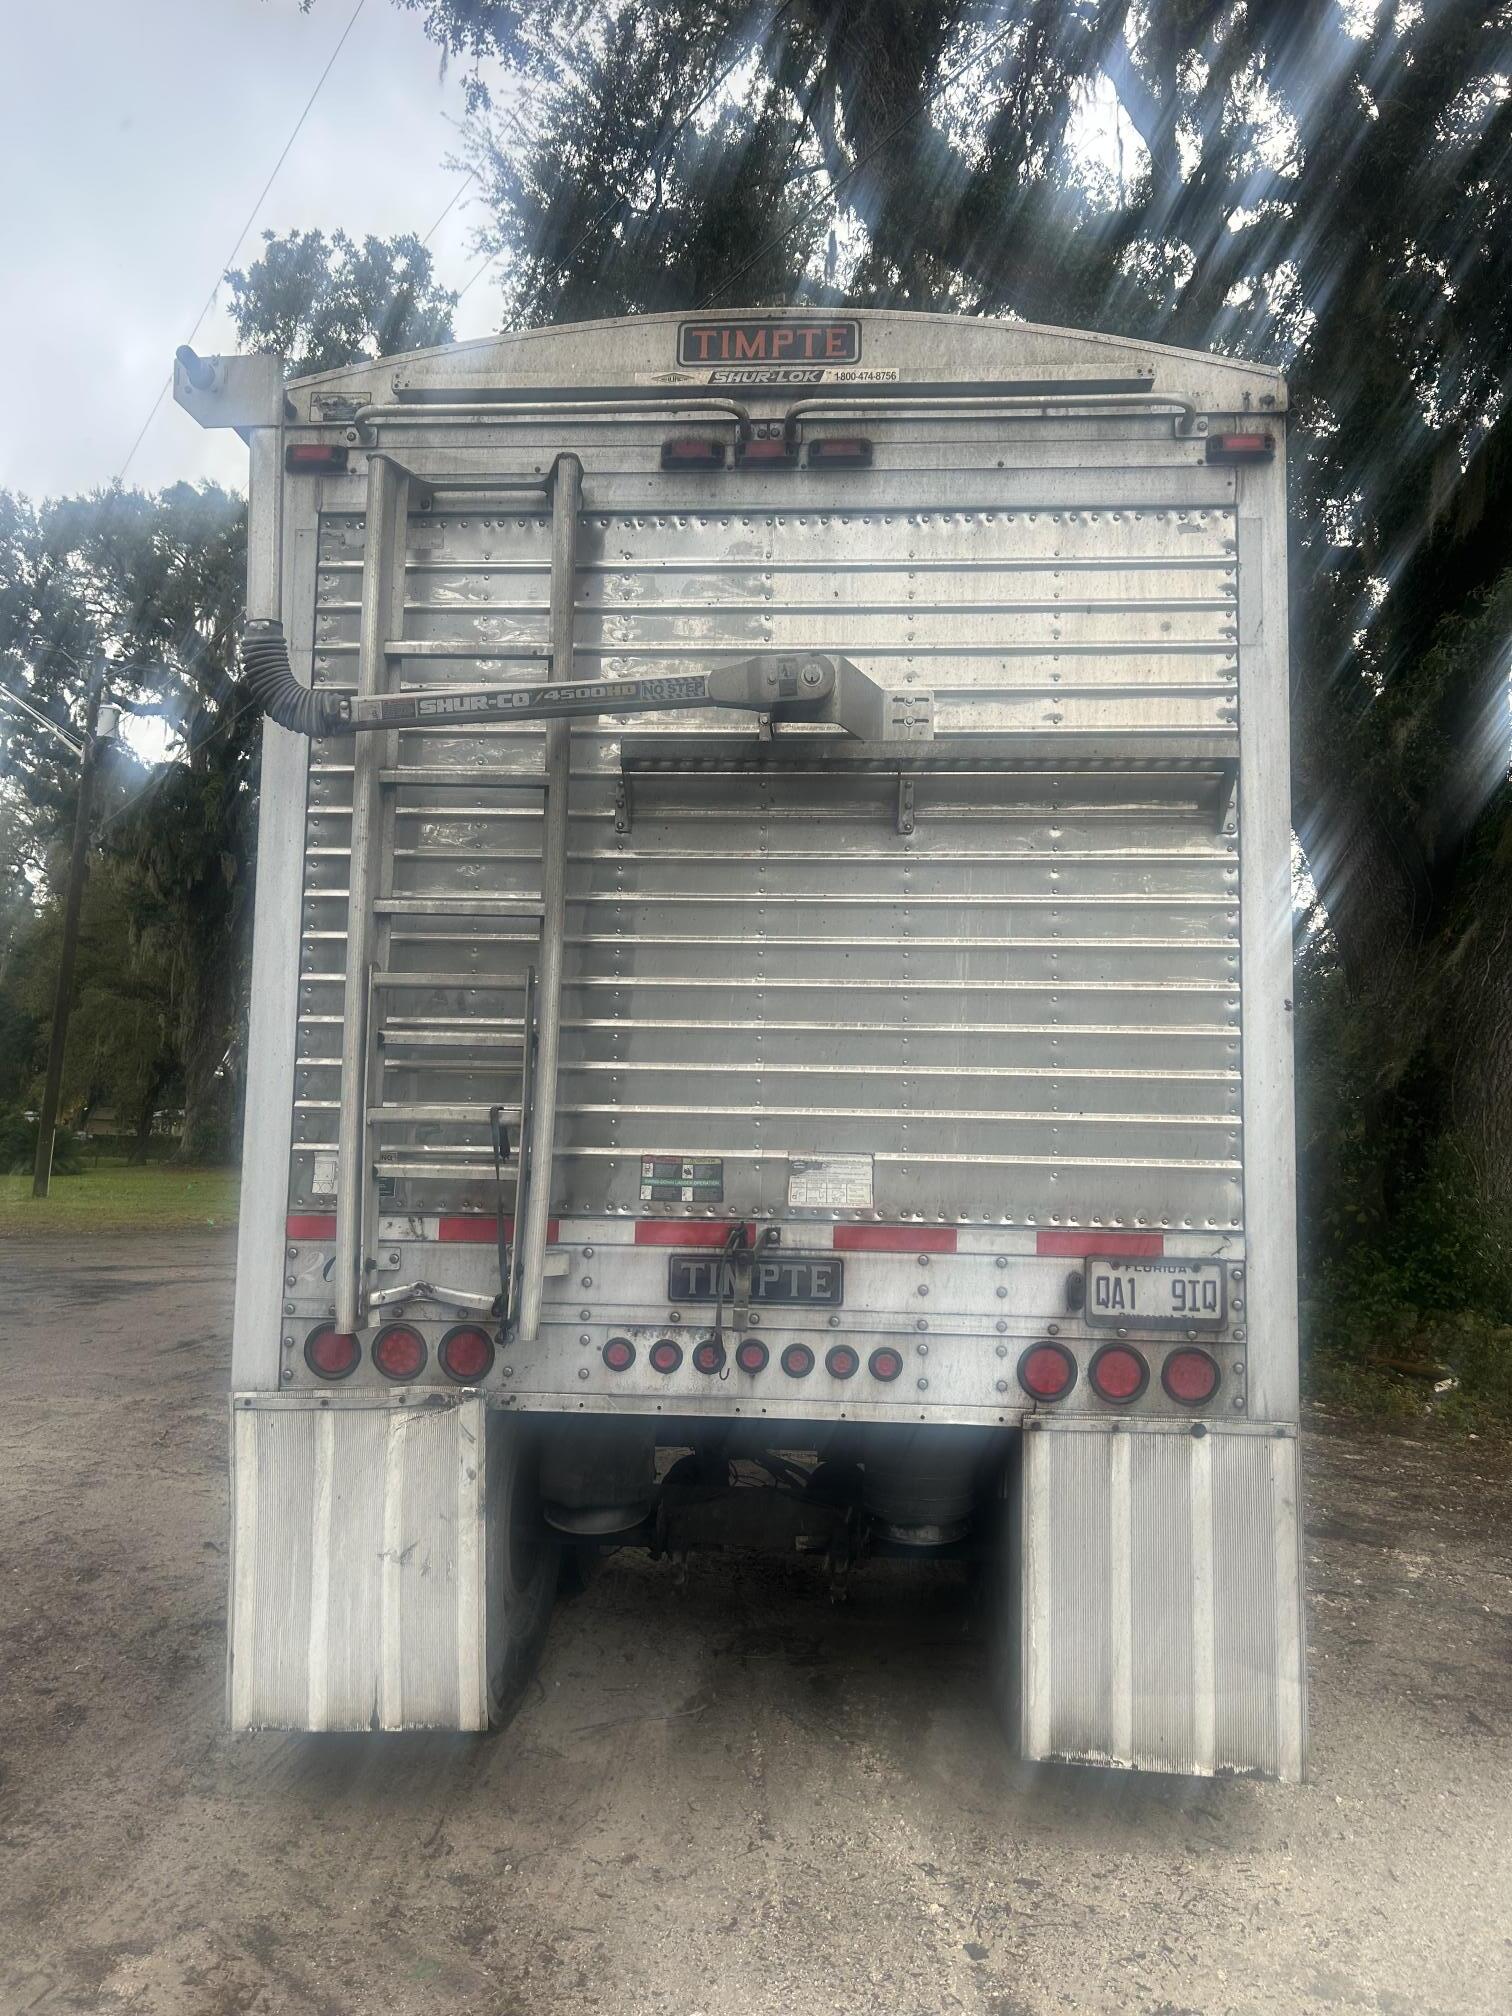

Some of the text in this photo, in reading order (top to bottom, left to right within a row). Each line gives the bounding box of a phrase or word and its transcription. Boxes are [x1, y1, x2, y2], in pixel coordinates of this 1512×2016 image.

[692, 328, 848, 360] TIMPTE
[834, 371, 897, 382] 1-800-474-8756
[419, 692, 530, 715] SHUR-CO
[543, 684, 637, 700] 4500HD
[642, 680, 703, 696] NO STEP
[1096, 1275, 1136, 1310] QA1
